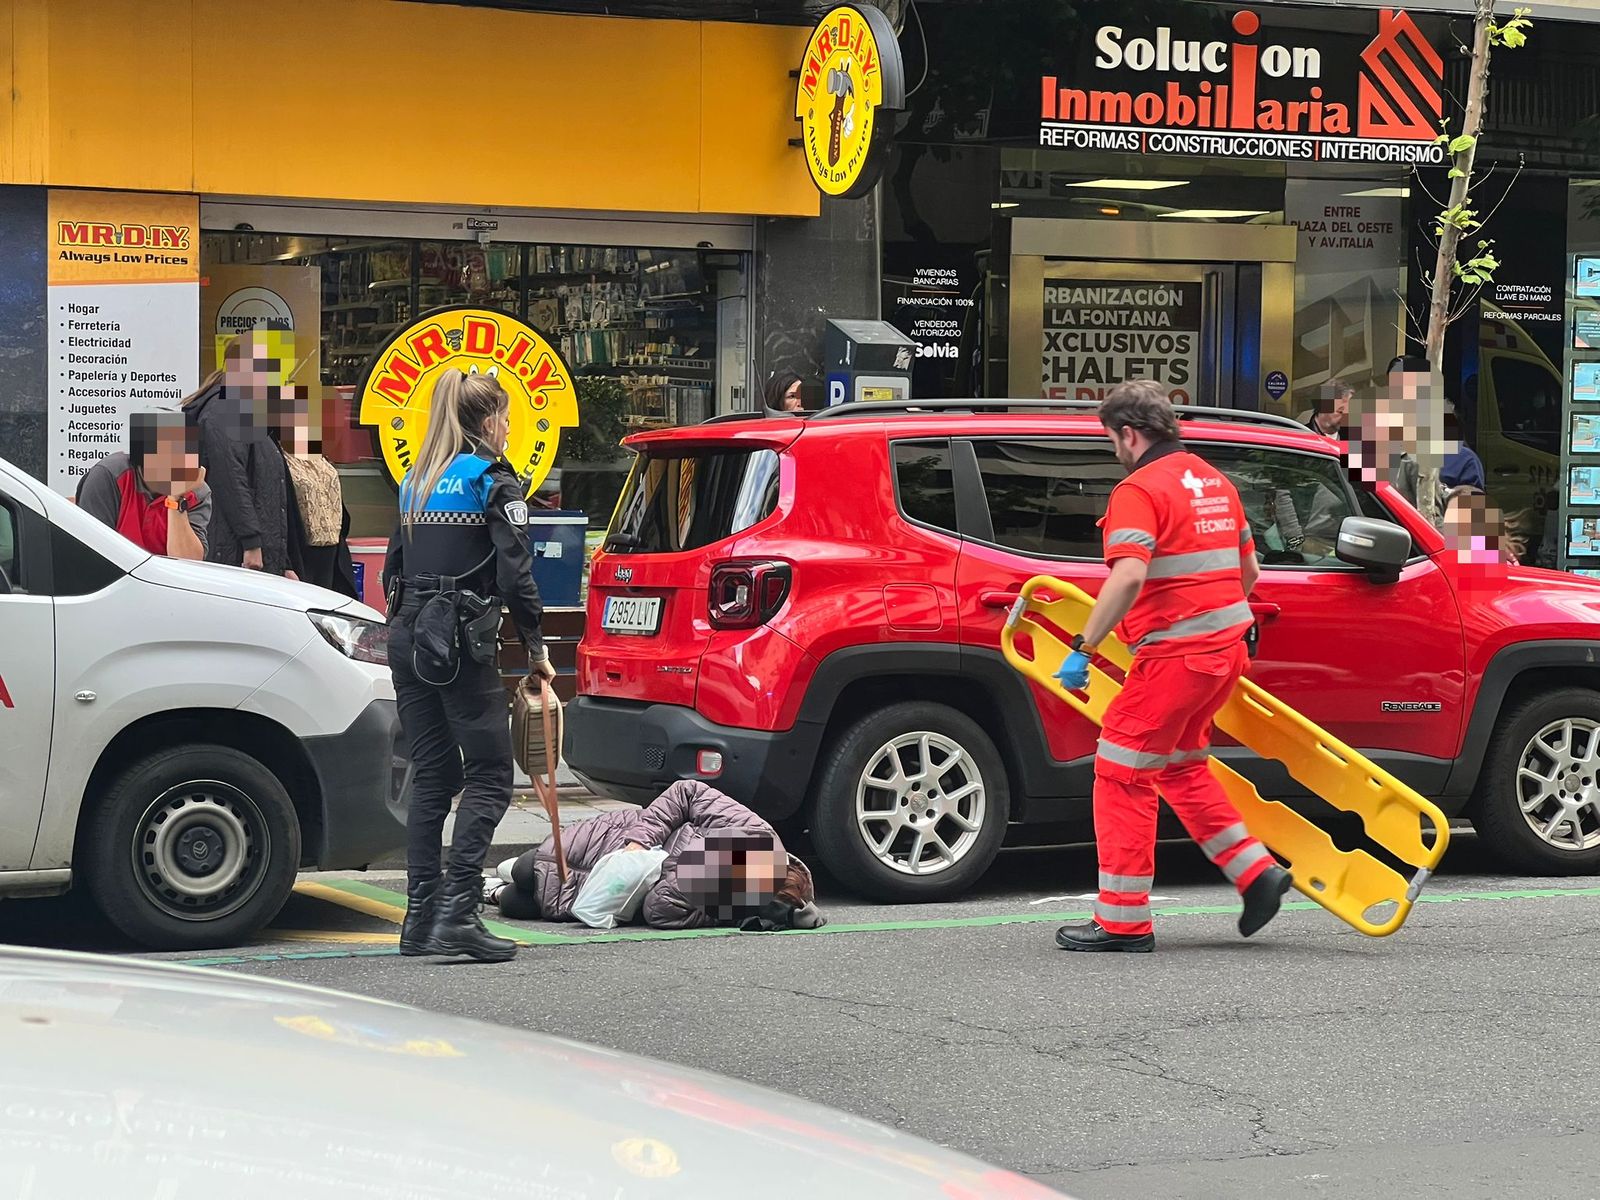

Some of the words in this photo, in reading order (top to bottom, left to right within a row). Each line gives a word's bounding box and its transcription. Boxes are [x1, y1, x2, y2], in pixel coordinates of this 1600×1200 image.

[1040, 128, 1140, 150] REFORMAS
[1148, 134, 1313, 158] CONSTRUCCIONES
[1321, 142, 1443, 163] INTERIORISMO
[1323, 206, 1361, 218] ENTRE
[1331, 221, 1353, 233] DEL
[1357, 222, 1393, 233] OESTE
[60, 223, 116, 246] MR
[1308, 236, 1316, 248] Y
[1320, 237, 1374, 249] AV.ITALIA
[59, 250, 111, 264] Always
[114, 252, 142, 263] Low
[145, 254, 188, 265] Prices
[915, 268, 957, 277] VIVIENDAS
[913, 277, 959, 286] BANCARIAS
[1496, 284, 1552, 294] CONTRATACIÓN
[897, 296, 953, 306] FINANCIACIÓN
[955, 298, 975, 307] 100%
[1044, 285, 1183, 307] RBANIZACIÓN
[1495, 293, 1518, 301] LLAVE
[1518, 293, 1529, 301] EN
[1530, 294, 1552, 302] MANO
[68, 303, 100, 316] Hogar
[220, 316, 257, 328] PRECIOS
[1051, 309, 1076, 325] LA
[1079, 309, 1171, 327] FONTANA
[1483, 311, 1522, 320] REFORMAS
[1523, 313, 1562, 321] PARCIALES
[68, 320, 121, 331] Ferretería
[914, 320, 958, 328] VENDEDOR
[910, 329, 962, 337] AUTORIZADO
[68, 337, 132, 348] Electricidad
[1044, 332, 1191, 354] XCLUSIVOS
[914, 342, 959, 358] Solvia
[68, 354, 128, 365] Decoración
[376, 327, 452, 407] MR
[68, 370, 118, 382] Papelería
[121, 372, 127, 383] y
[130, 371, 177, 383] Deportes
[68, 387, 127, 397] Accesorios
[129, 388, 182, 399] Automóvil
[830, 380, 846, 407] P
[68, 403, 117, 415] Juguetes
[1193, 518, 1236, 535] TÉCNICO
[609, 600, 637, 625] 2952
[1381, 701, 1442, 712] RENEGADE
